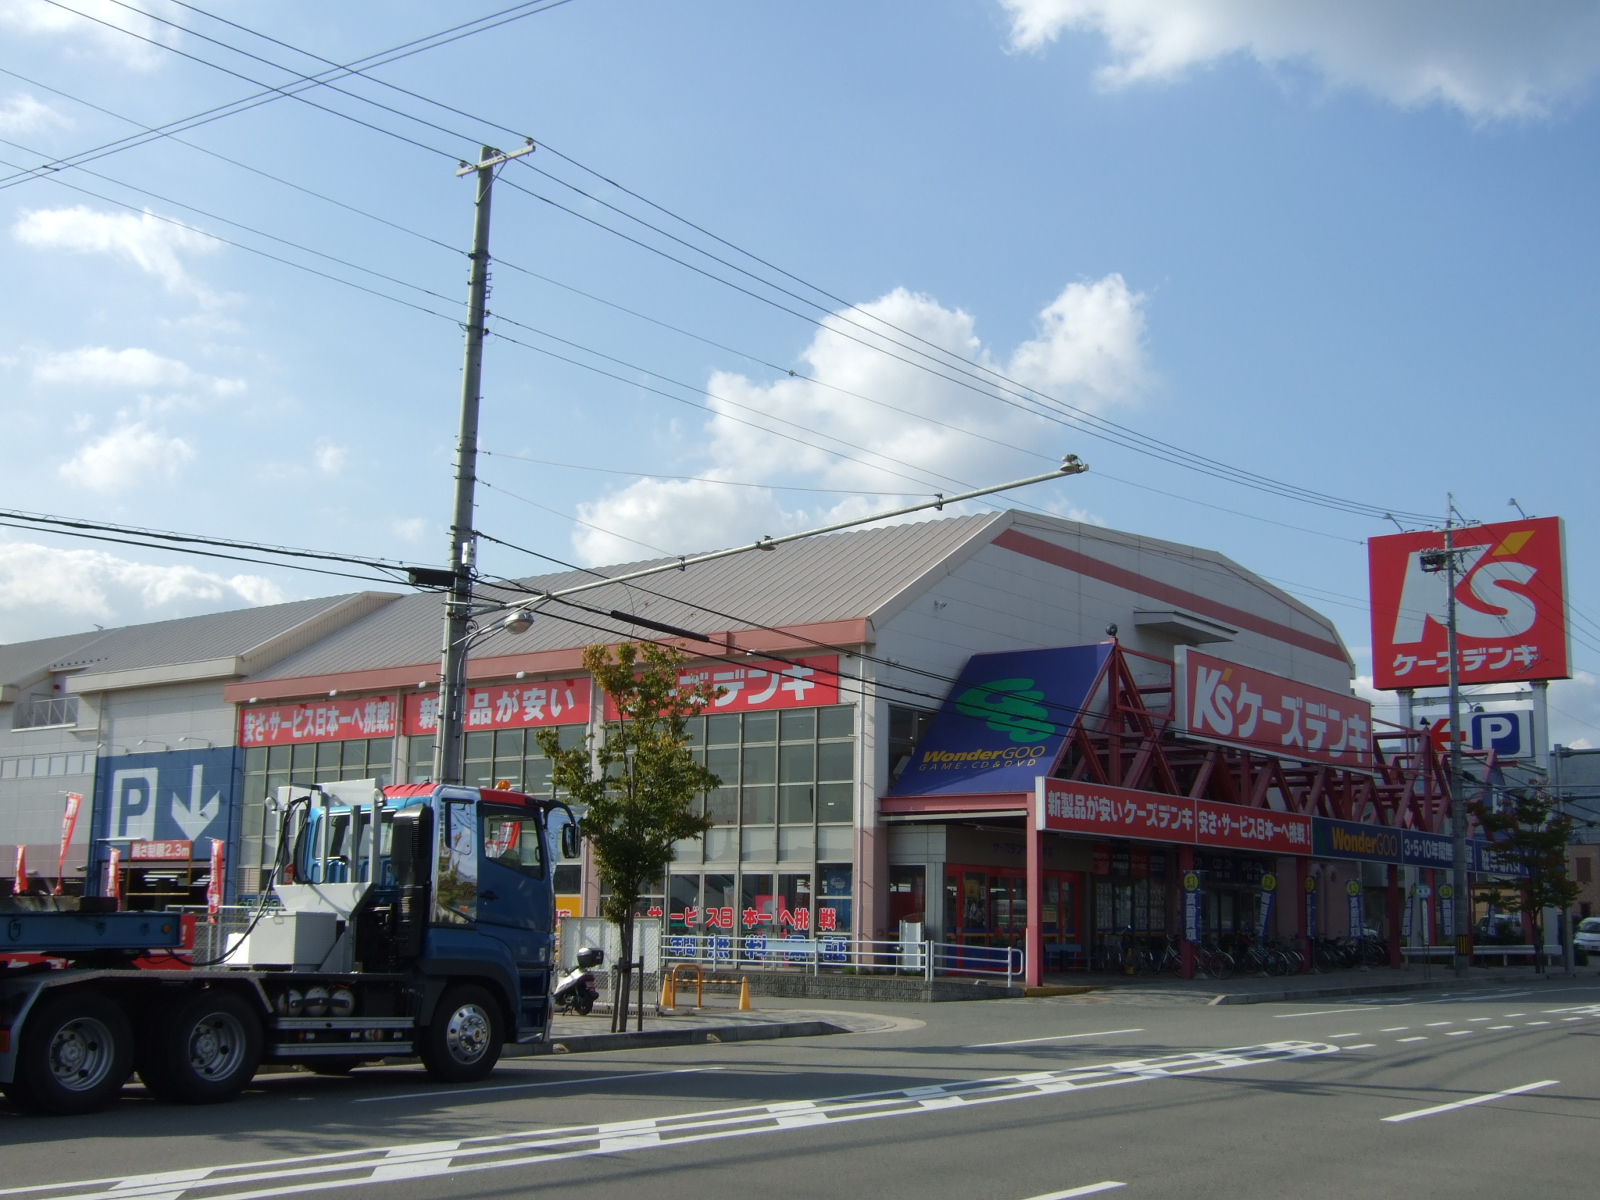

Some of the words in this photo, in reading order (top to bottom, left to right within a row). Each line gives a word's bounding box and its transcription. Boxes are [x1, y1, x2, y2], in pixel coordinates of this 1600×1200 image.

[1393, 645, 1539, 676] ケーズデンキ
[419, 688, 575, 729] 新品が安い
[1481, 717, 1513, 749] P
[923, 745, 1046, 763] WonderGOO
[116, 775, 152, 838] P
[1048, 791, 1193, 831] 新製品が安いケーズデンキ
[131, 843, 190, 858] 高さ制限2.3m
[1331, 826, 1398, 857] WonderGOO
